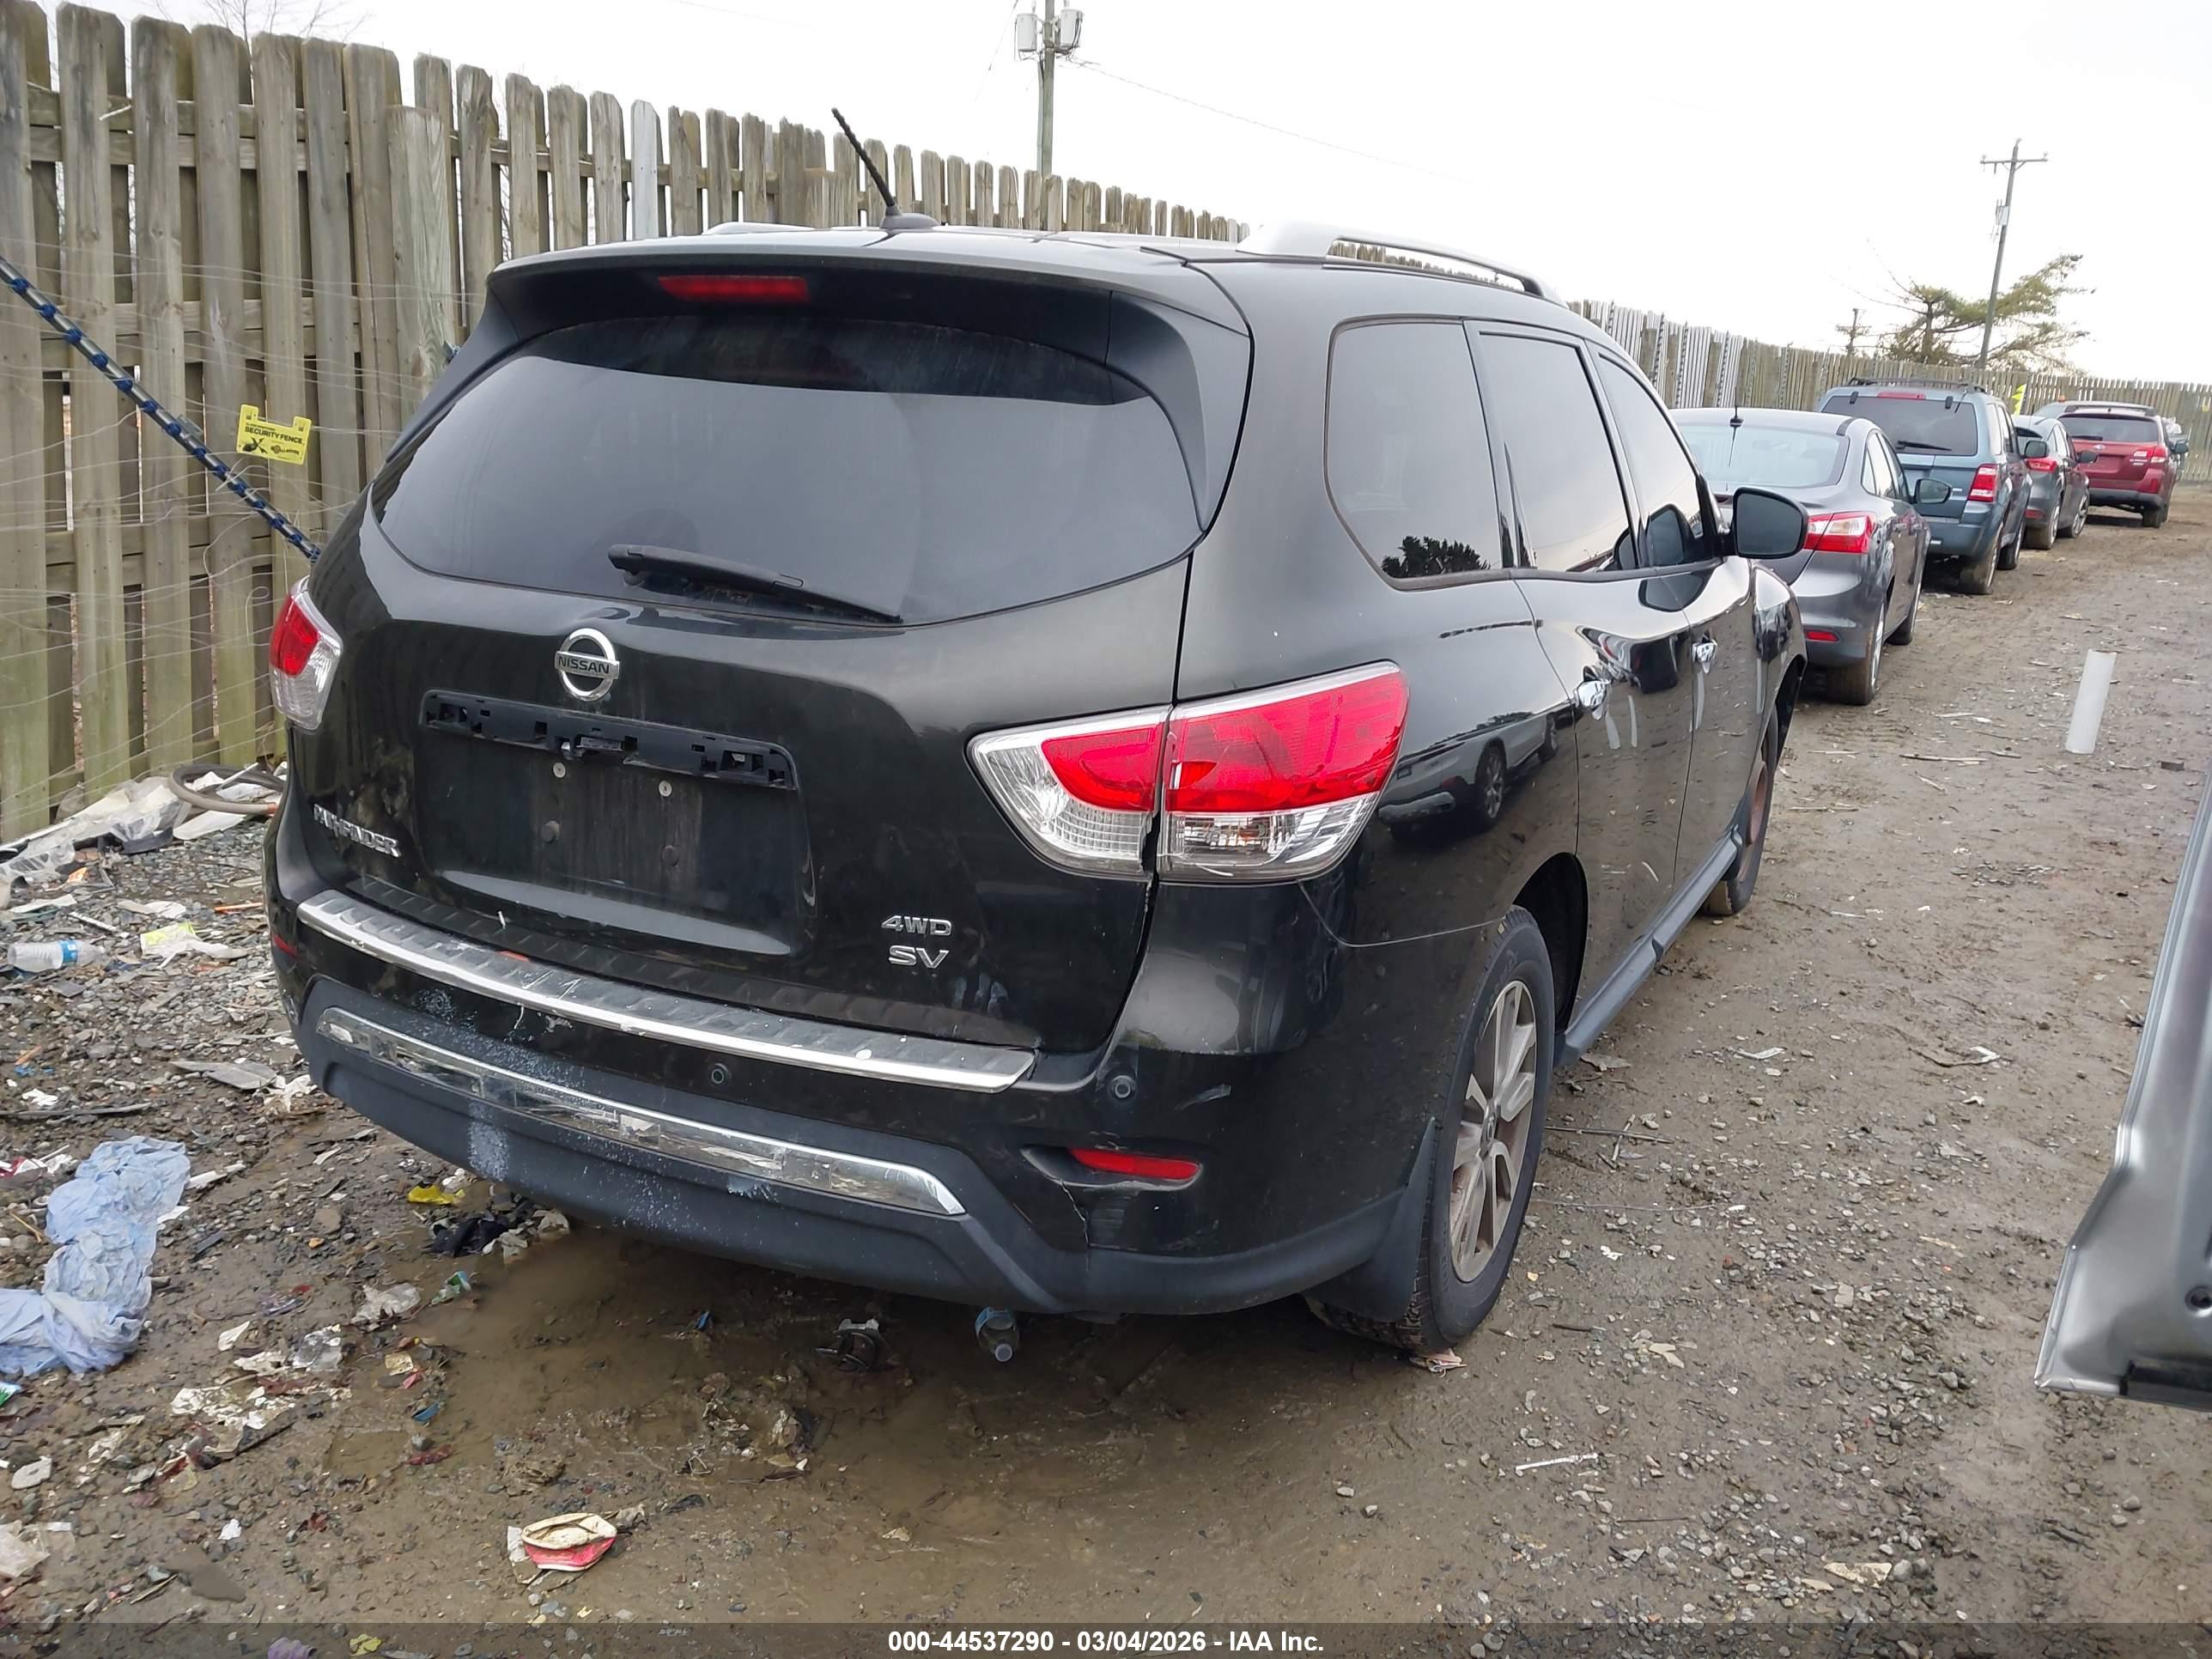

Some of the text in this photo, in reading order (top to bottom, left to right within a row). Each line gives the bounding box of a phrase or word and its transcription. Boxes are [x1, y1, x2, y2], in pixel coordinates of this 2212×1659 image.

[245, 426, 280, 440] SECURITY
[280, 434, 303, 444] FENCE
[558, 656, 610, 674] NISSAN
[881, 915, 951, 935] 4WD
[888, 945, 950, 969] SV
